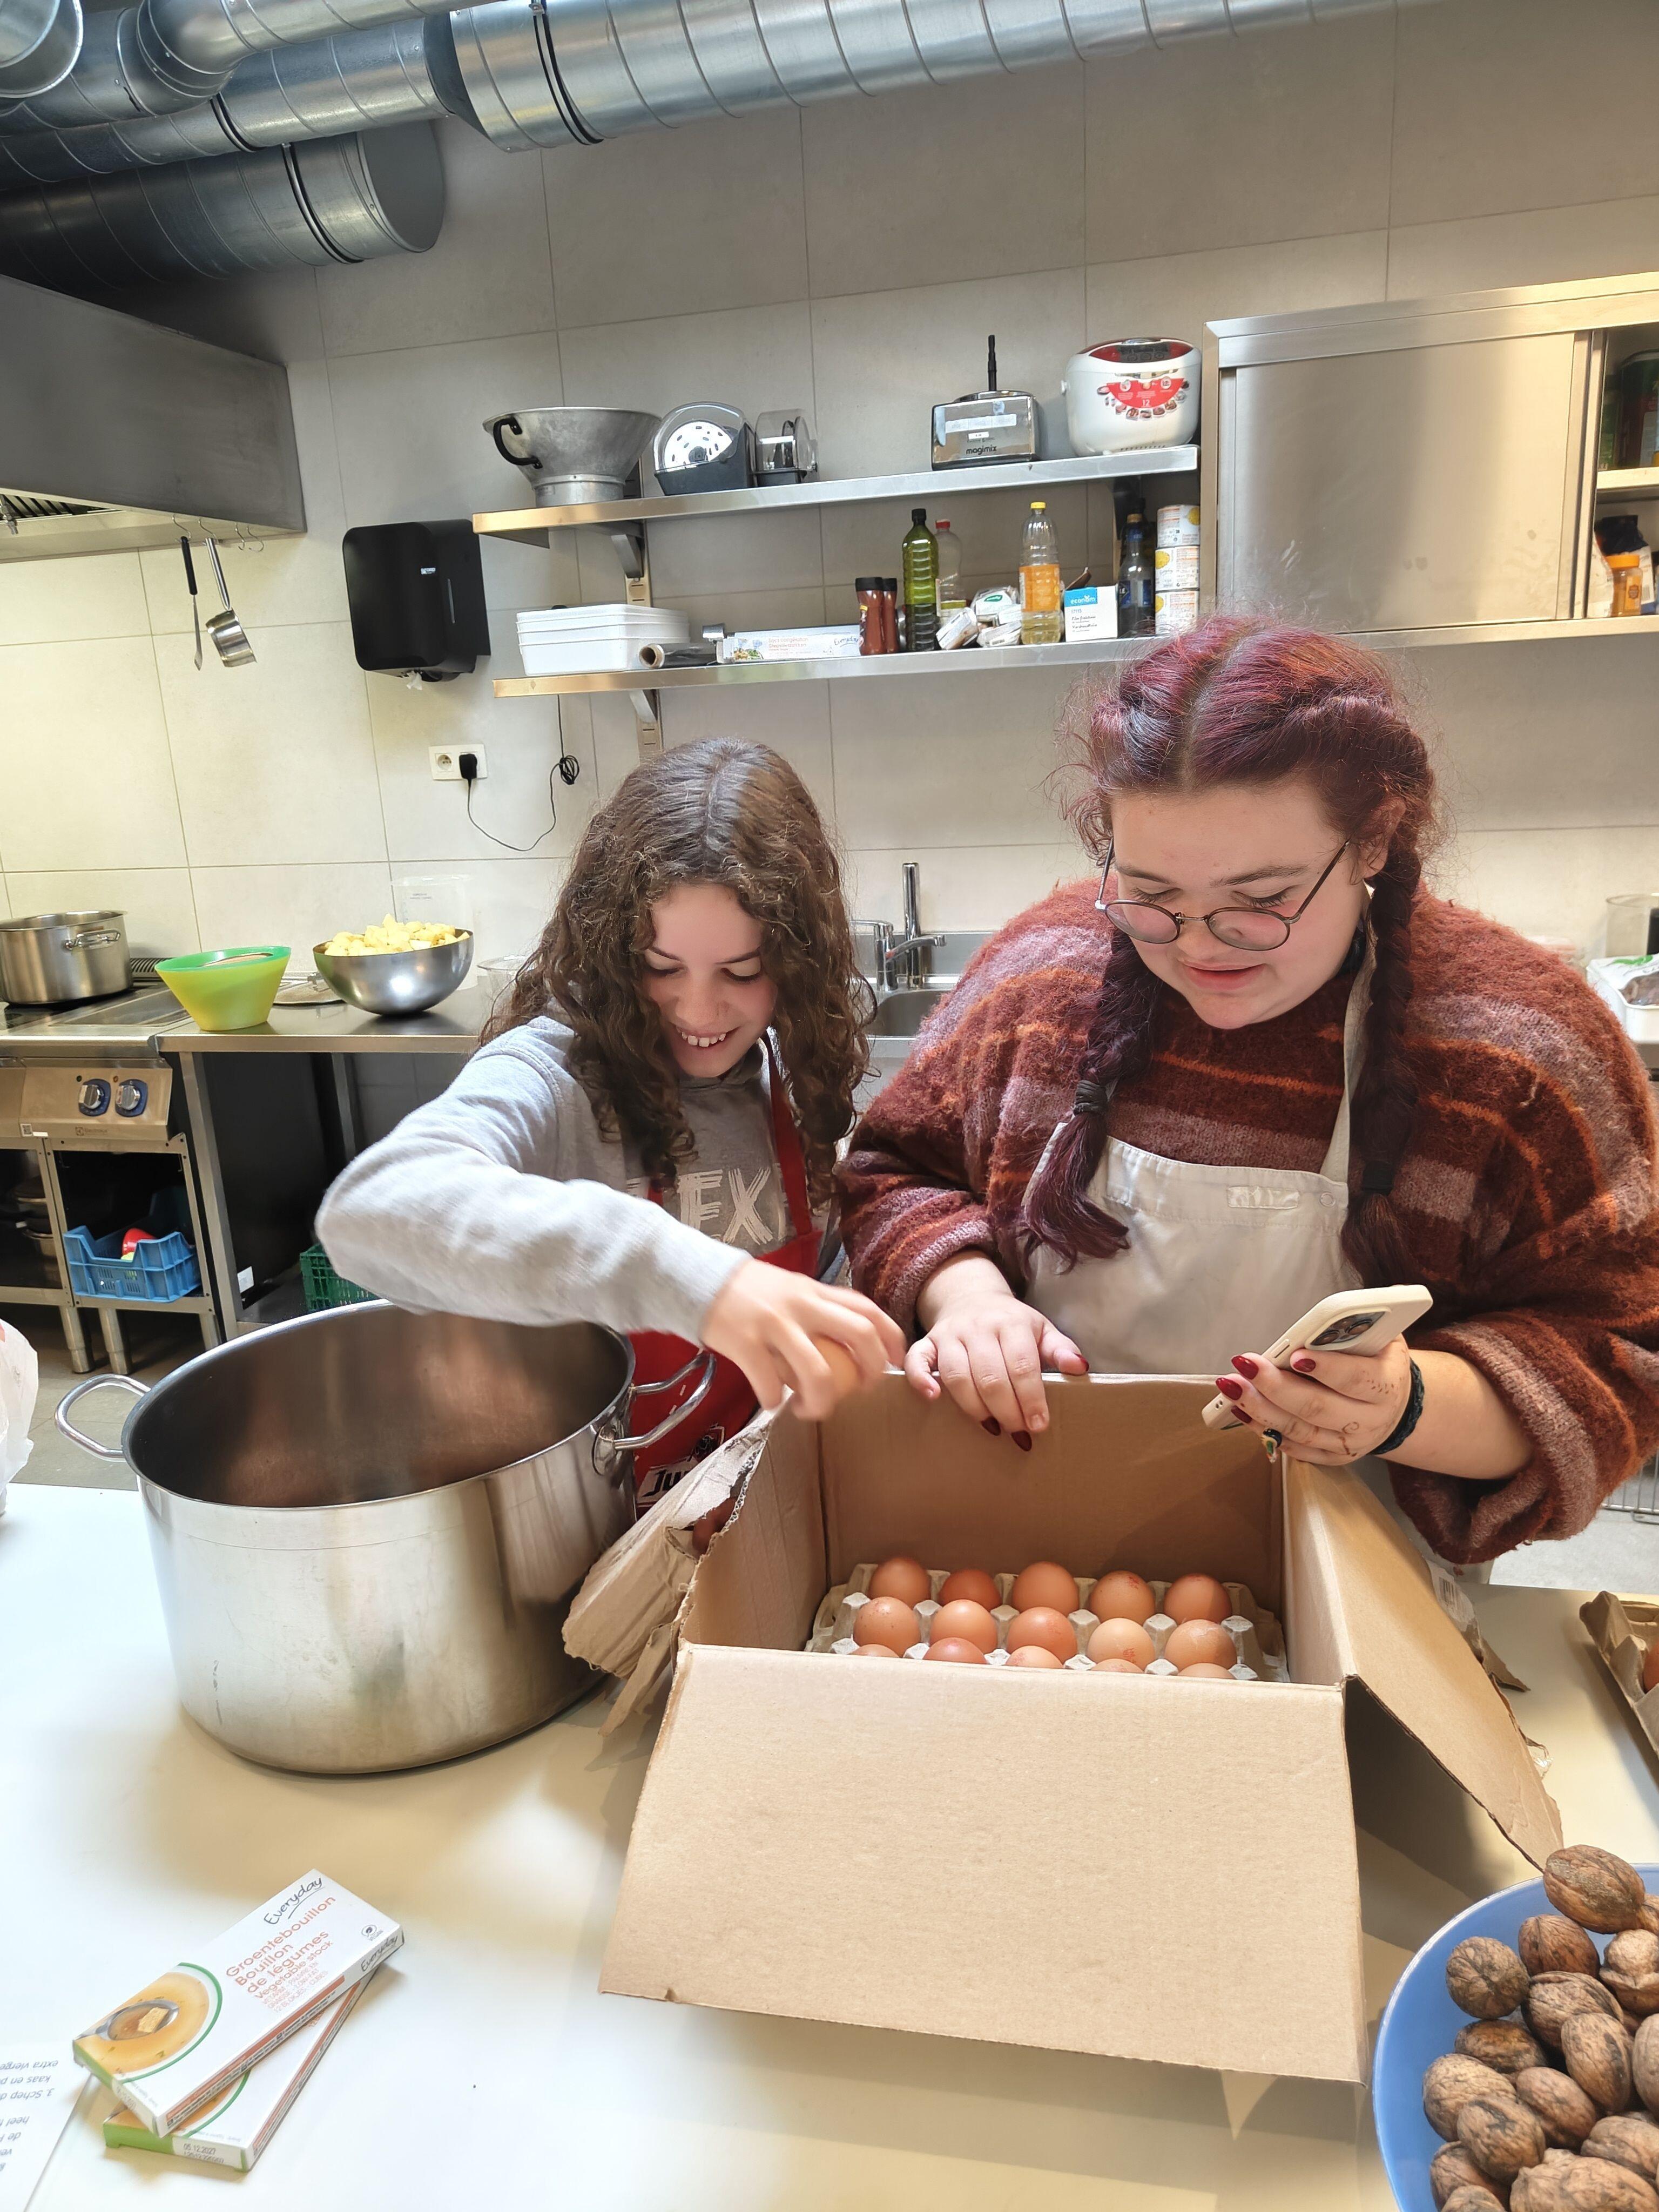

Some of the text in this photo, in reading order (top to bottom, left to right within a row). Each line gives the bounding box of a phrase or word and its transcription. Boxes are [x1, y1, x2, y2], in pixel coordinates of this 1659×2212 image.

[966, 444, 997, 455] magimix
[264, 1877, 324, 1925] Everyday
[226, 1896, 336, 1977] Groentebouillon
[361, 1935, 398, 1972] Everyday
[235, 1944, 293, 1986] Bouillon
[247, 1931, 329, 1993] de légumes
[255, 1940, 334, 1998] Vegetable stock
[32, 2060, 59, 2068] extra
[10, 2089, 43, 2100] Schep
[5, 2116, 30, 2127] heel
[8, 2132, 22, 2141] de
